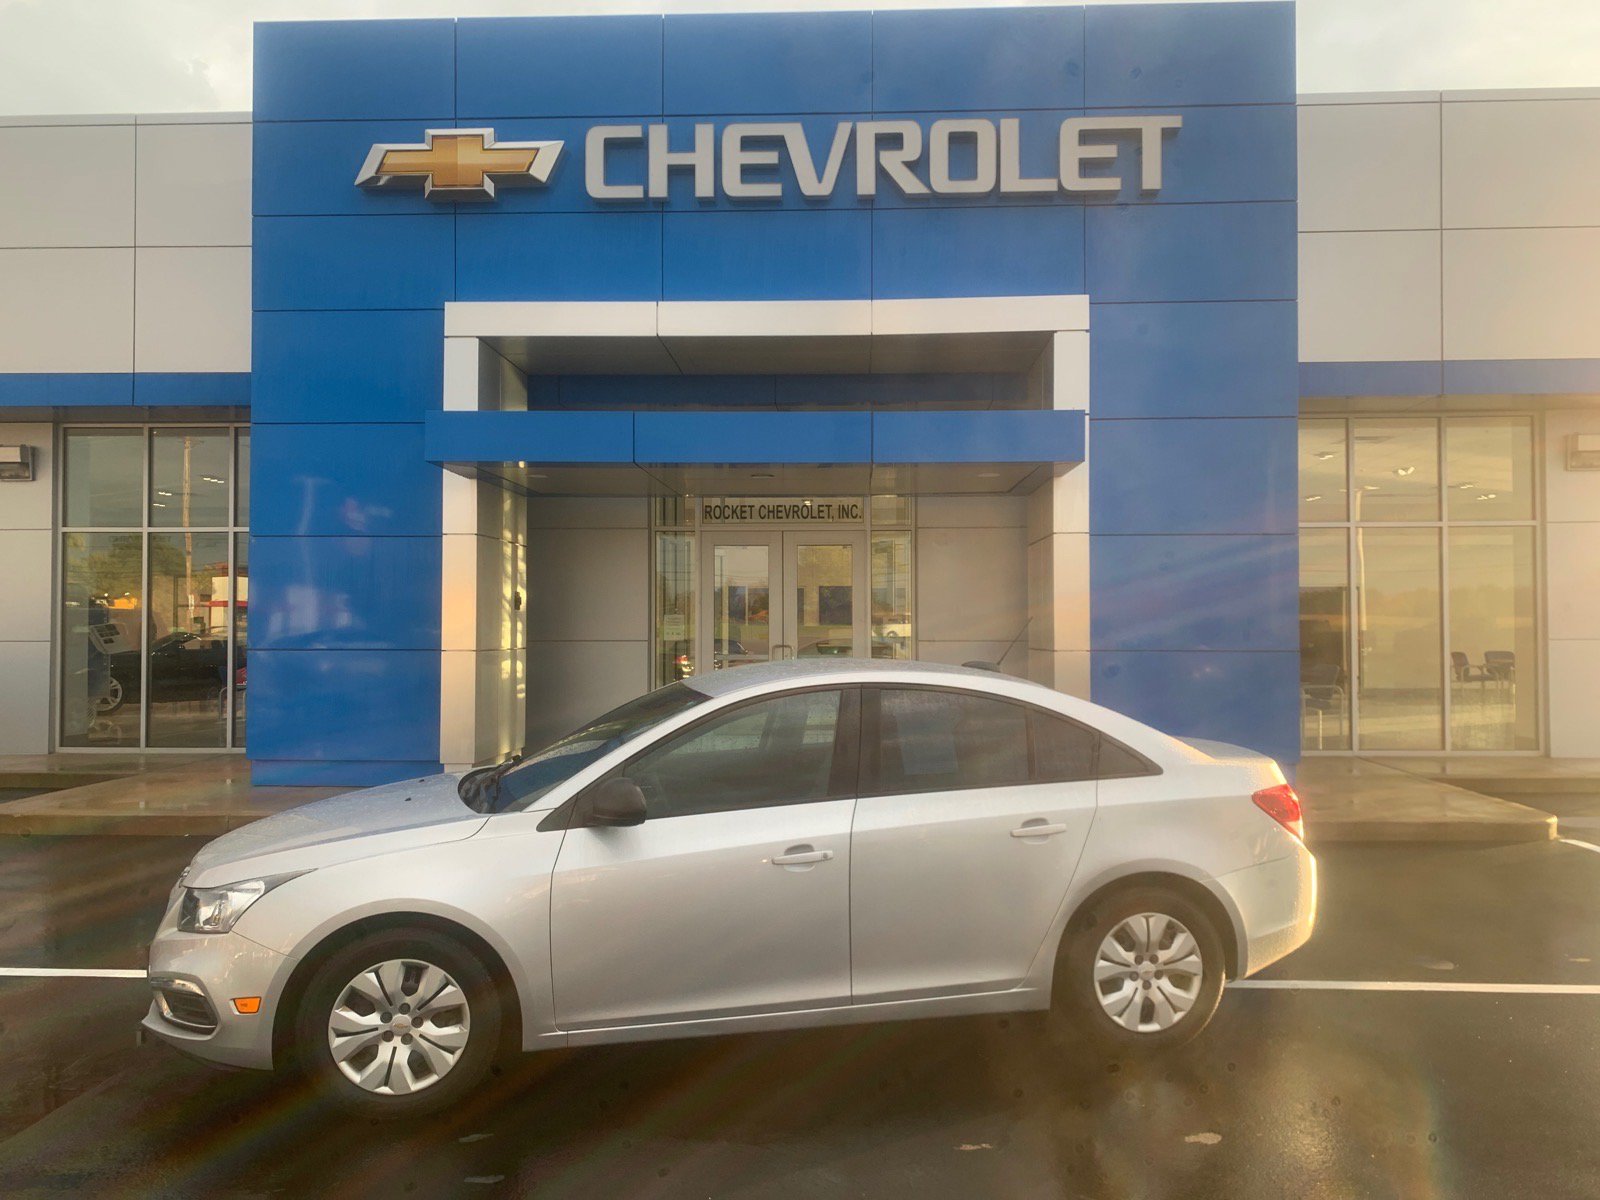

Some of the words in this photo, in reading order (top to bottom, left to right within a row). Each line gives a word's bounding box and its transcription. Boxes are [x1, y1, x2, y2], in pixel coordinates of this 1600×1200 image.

[585, 115, 1183, 199] CHEVROLET
[704, 505, 755, 520] ROCKET
[758, 504, 835, 522] CHEVROLET,
[838, 504, 862, 519] INC.
